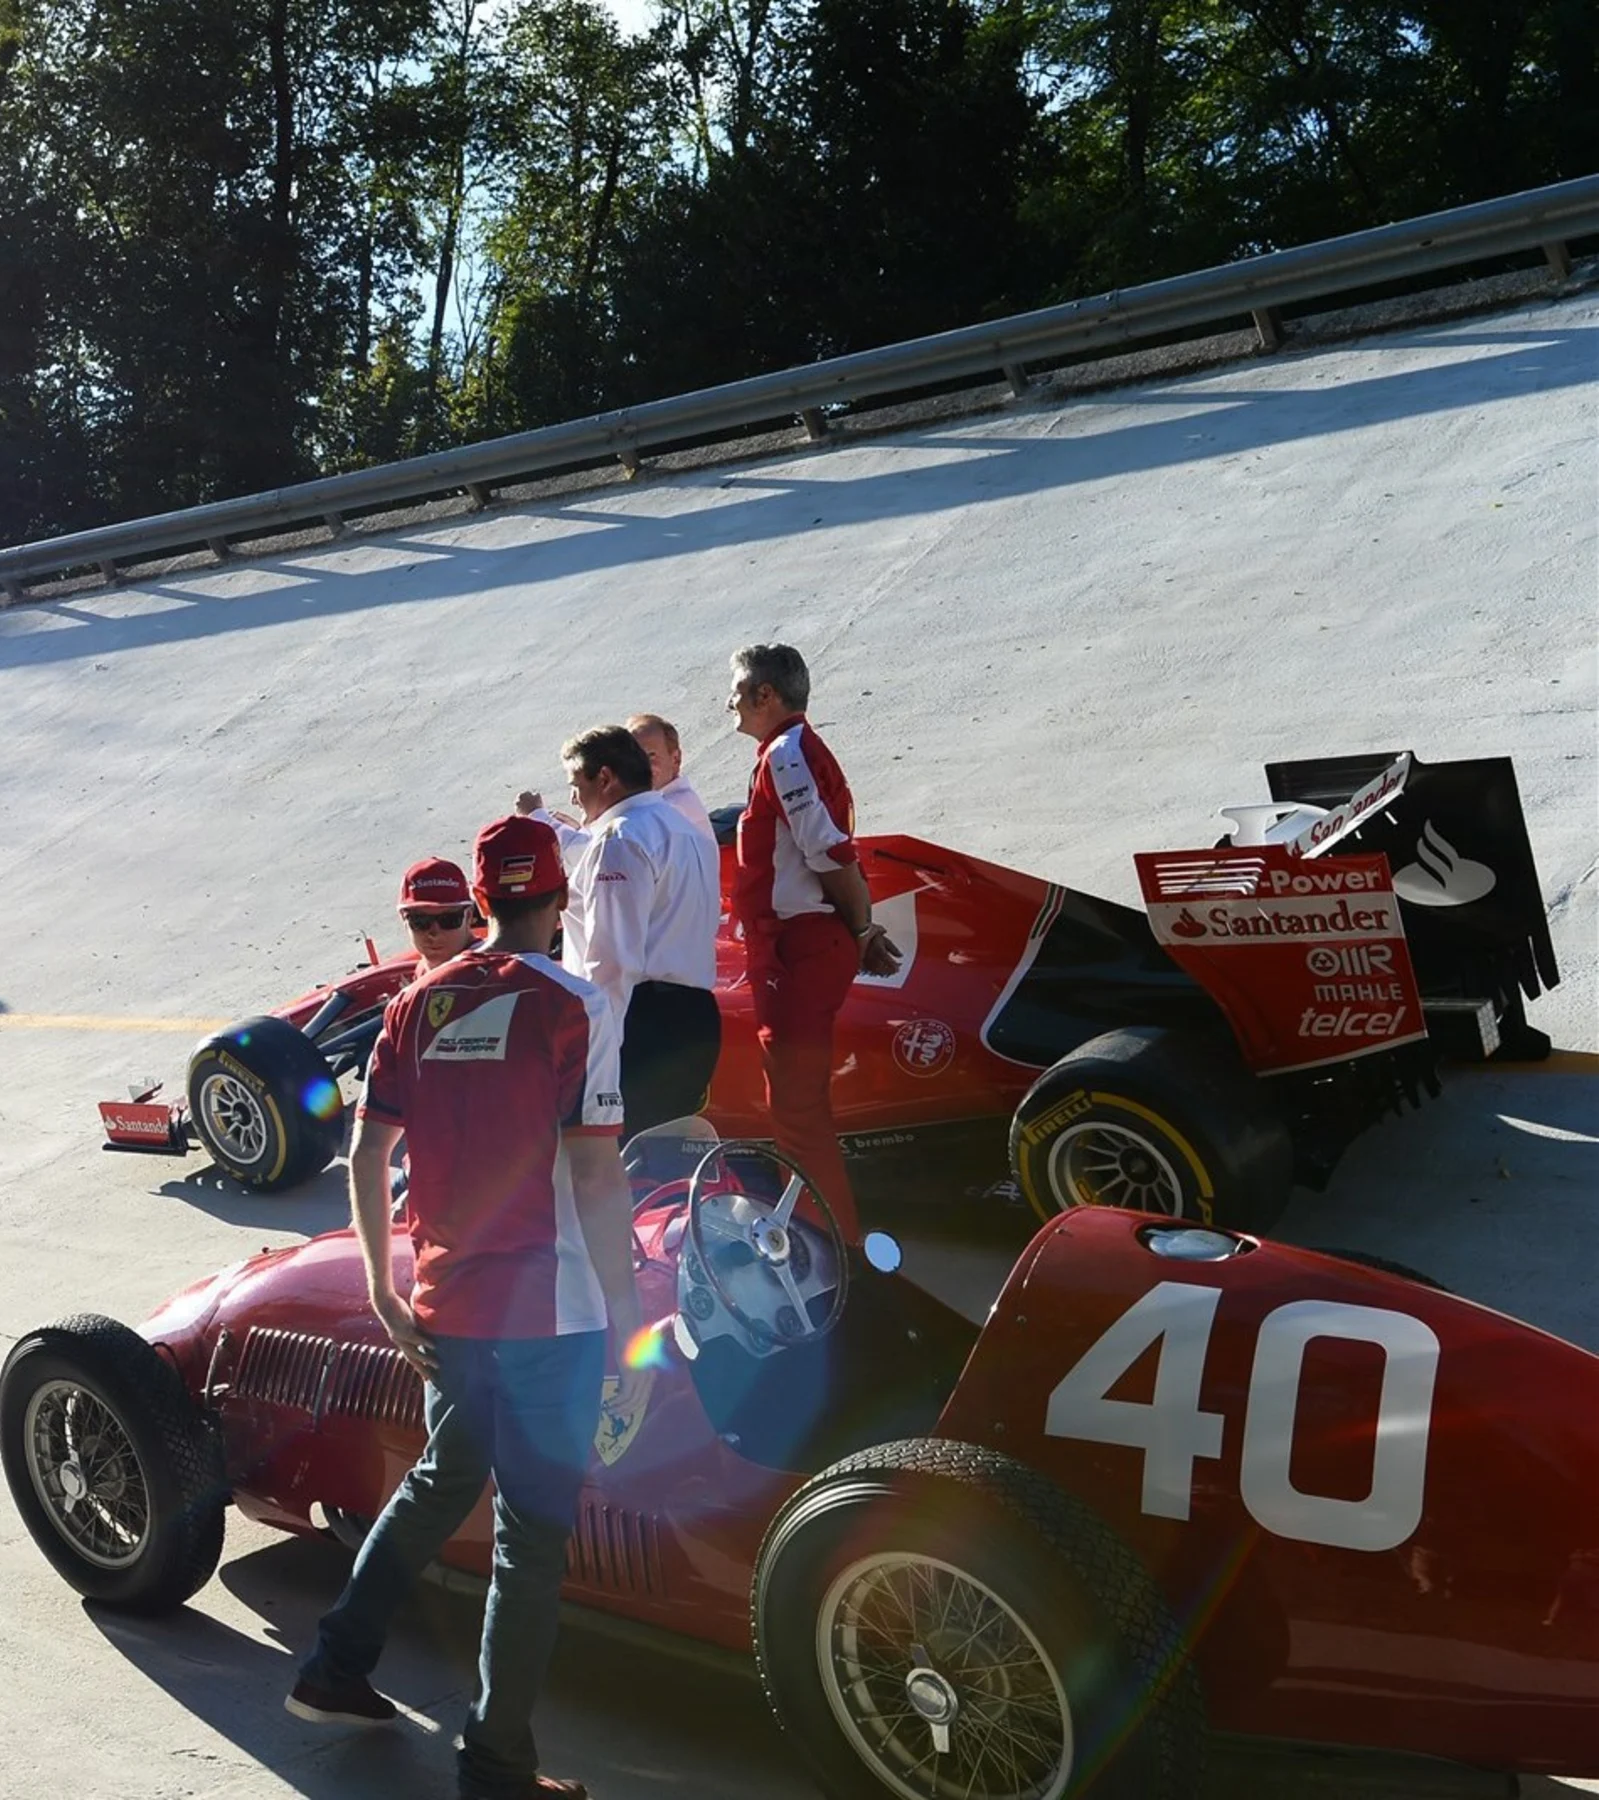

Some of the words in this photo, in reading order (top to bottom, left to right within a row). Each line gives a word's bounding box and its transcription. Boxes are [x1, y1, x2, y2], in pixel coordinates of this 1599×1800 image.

[1310, 768, 1406, 847] Sanander
[1208, 900, 1389, 937] Santander
[1314, 983, 1404, 1001] MAHLE
[1298, 1006, 1406, 1037] telcel
[1022, 1089, 1093, 1145] PIRELLI
[854, 1134, 915, 1149] brembo
[1044, 1280, 1441, 1552] 40
